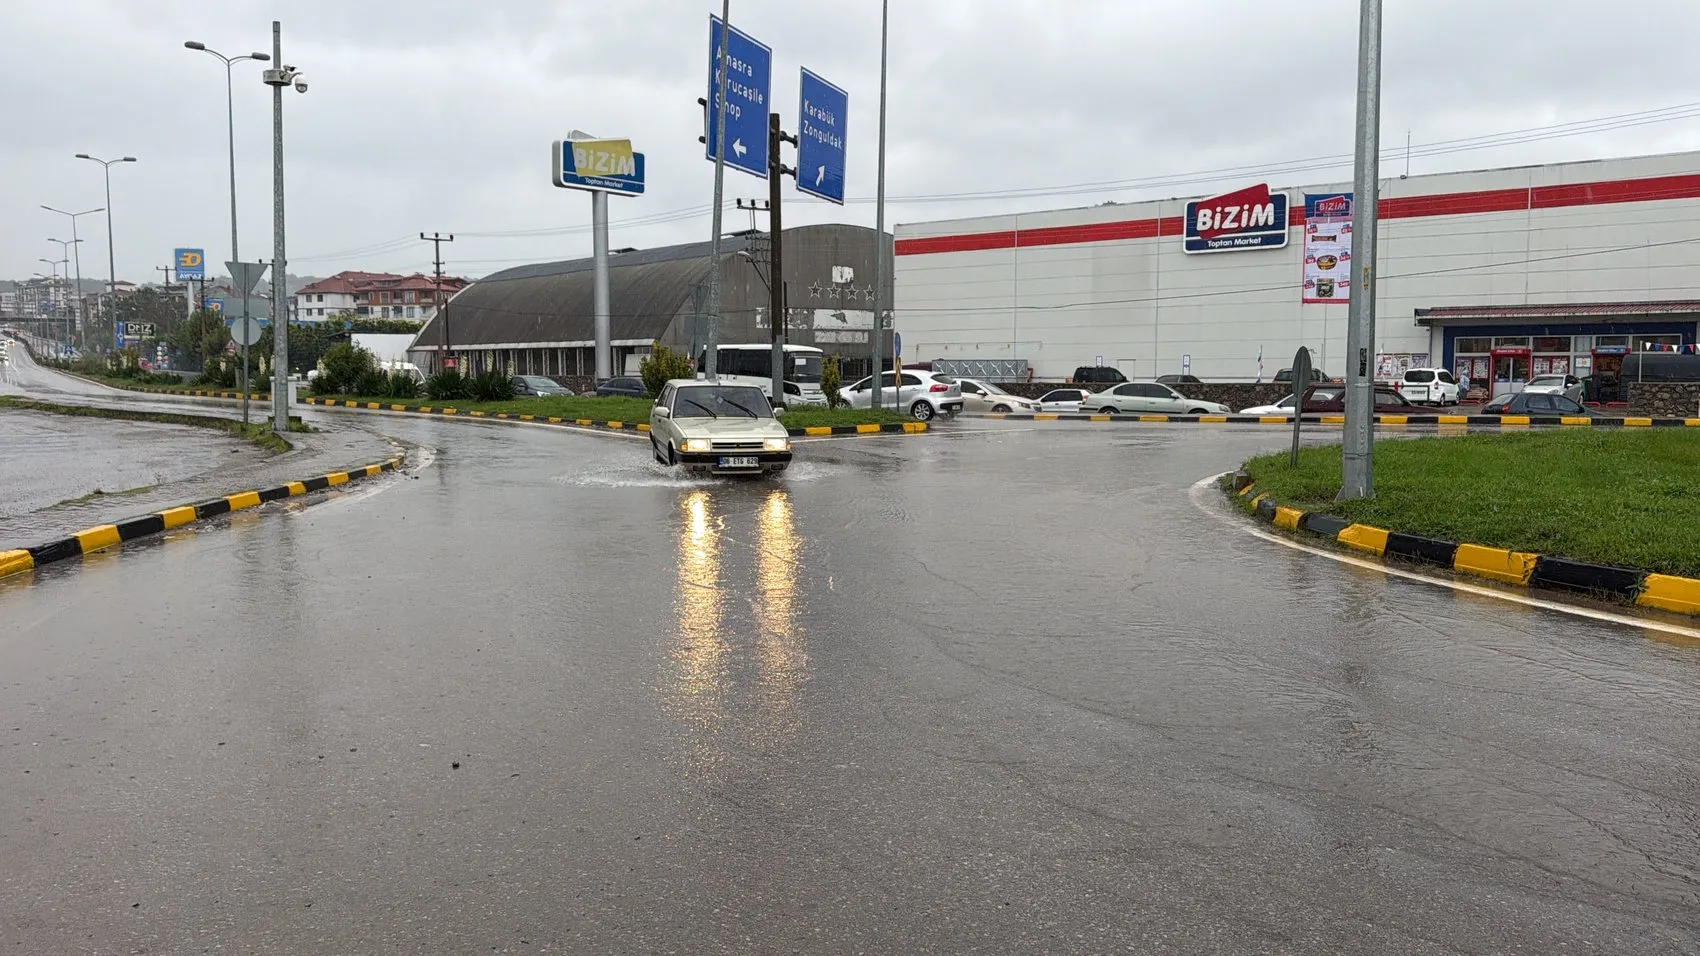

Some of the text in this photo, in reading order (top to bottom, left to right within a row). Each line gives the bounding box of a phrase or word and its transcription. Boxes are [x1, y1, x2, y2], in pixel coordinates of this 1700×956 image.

[715, 68, 763, 104] Krucaşile
[715, 93, 741, 121] Snop
[804, 98, 835, 127] Karabük
[803, 119, 842, 150] Zonguldak
[1207, 237, 1262, 249] Toptan Market
